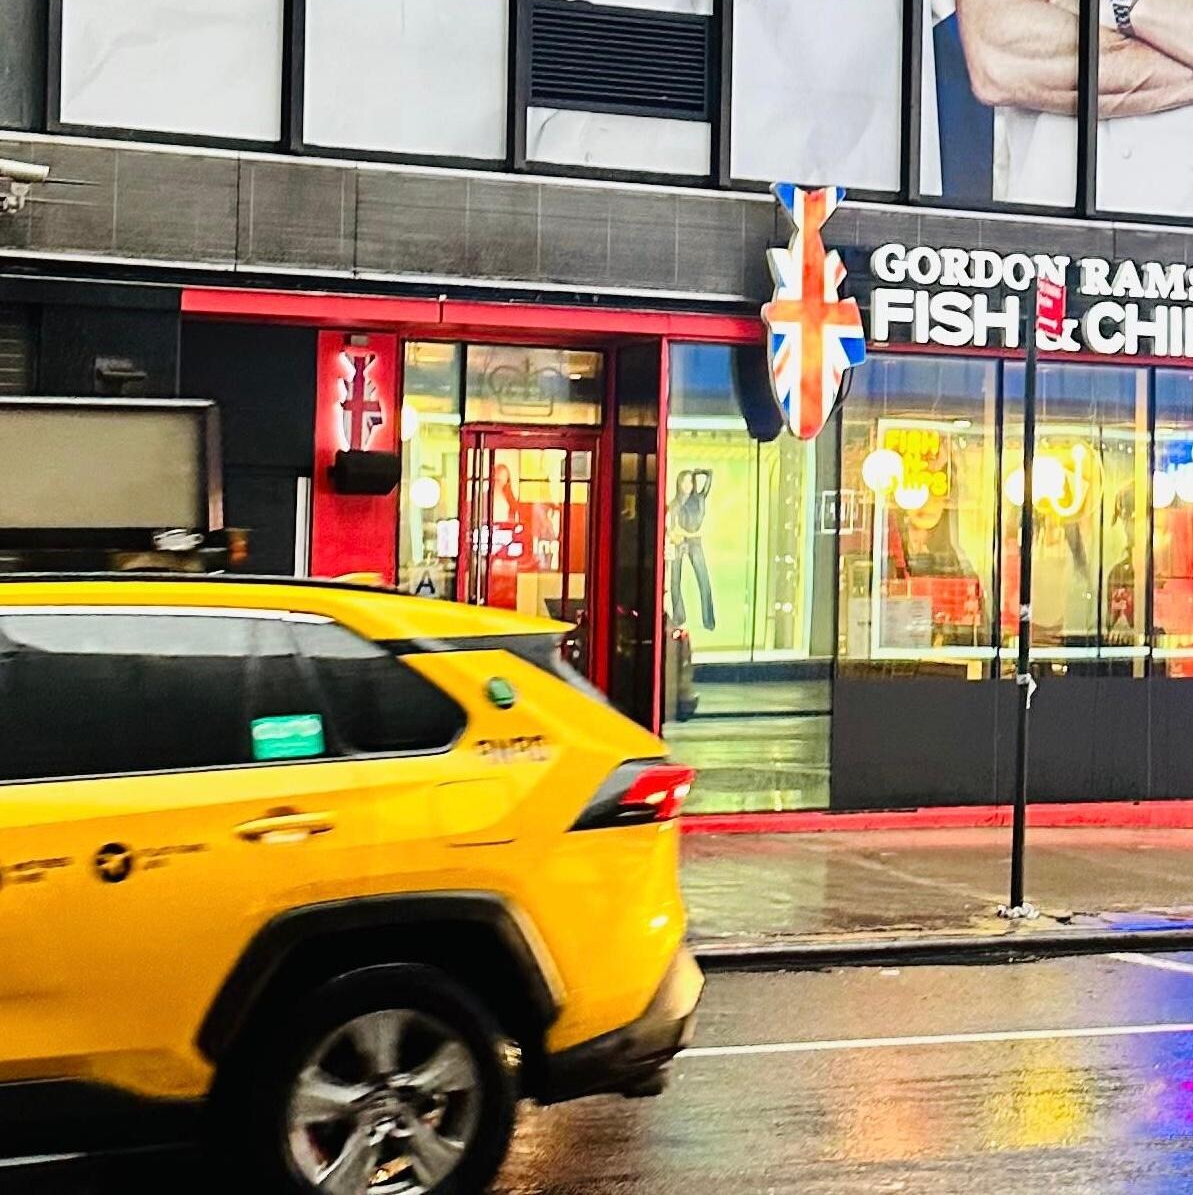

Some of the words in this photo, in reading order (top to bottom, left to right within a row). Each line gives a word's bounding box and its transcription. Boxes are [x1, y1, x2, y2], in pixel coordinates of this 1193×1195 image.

[872, 243, 1071, 291] GORDON
[872, 287, 1021, 349] FISH
[415, 569, 436, 595] A
